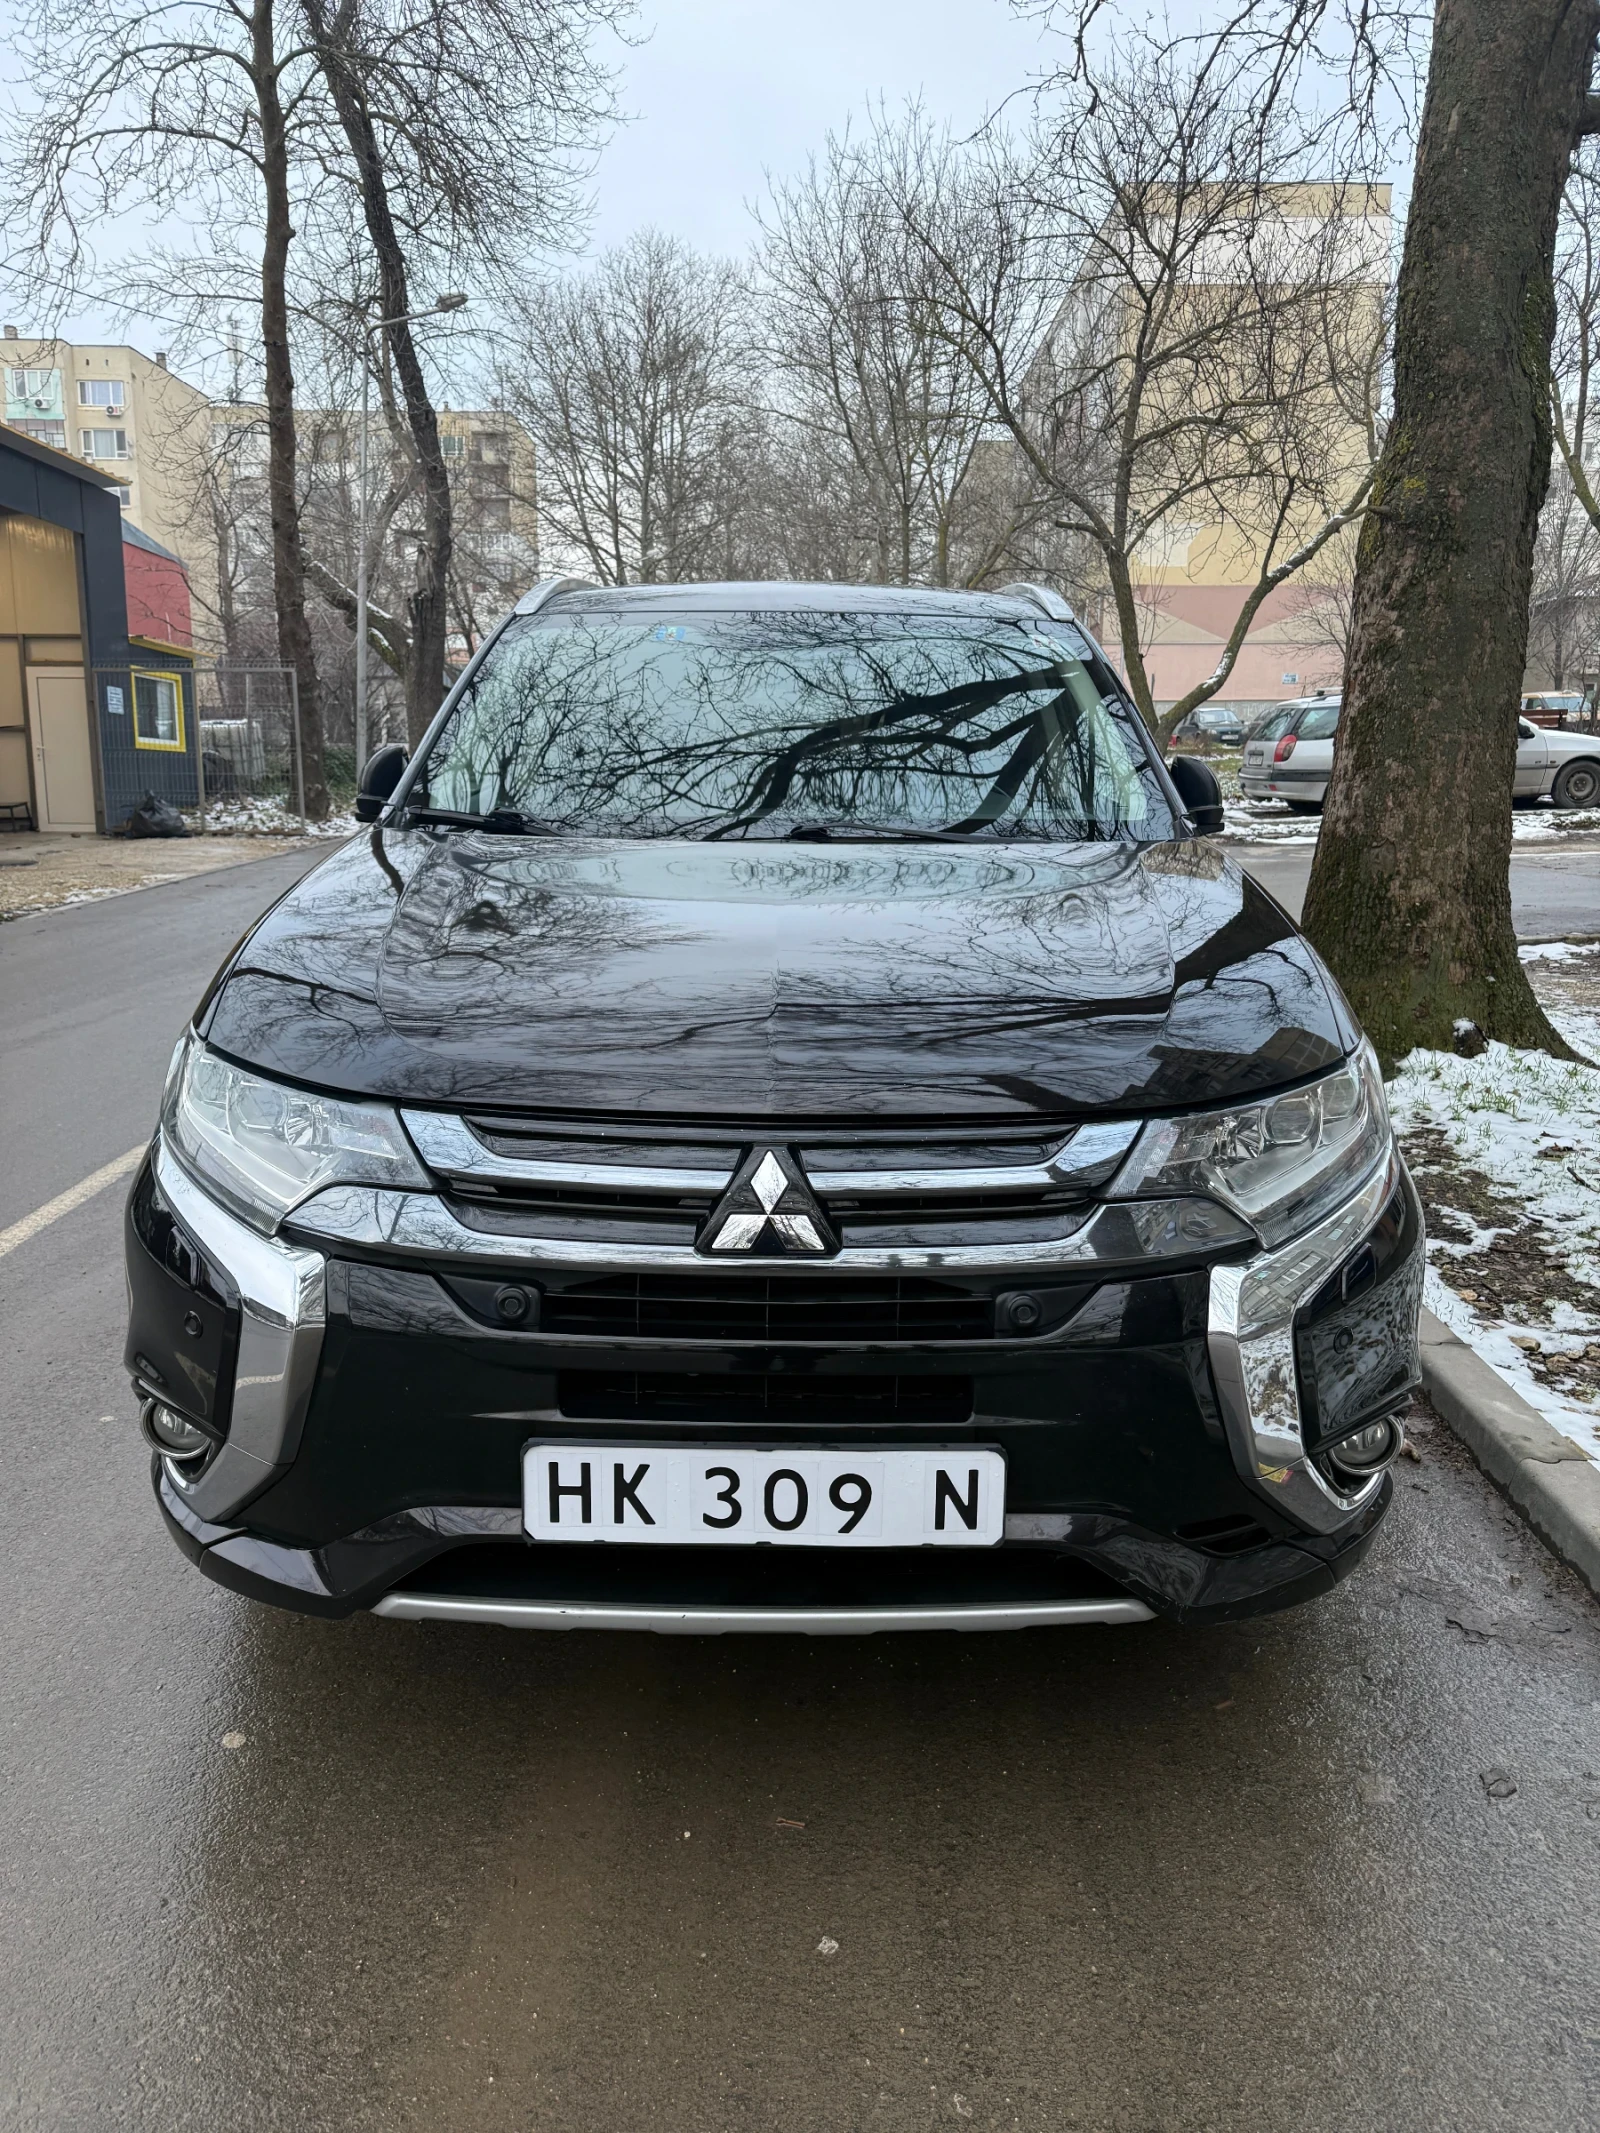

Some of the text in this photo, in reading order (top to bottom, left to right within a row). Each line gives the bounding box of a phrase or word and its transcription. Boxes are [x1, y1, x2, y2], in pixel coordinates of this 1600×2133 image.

[548, 1461, 979, 1534] HK 309 N
